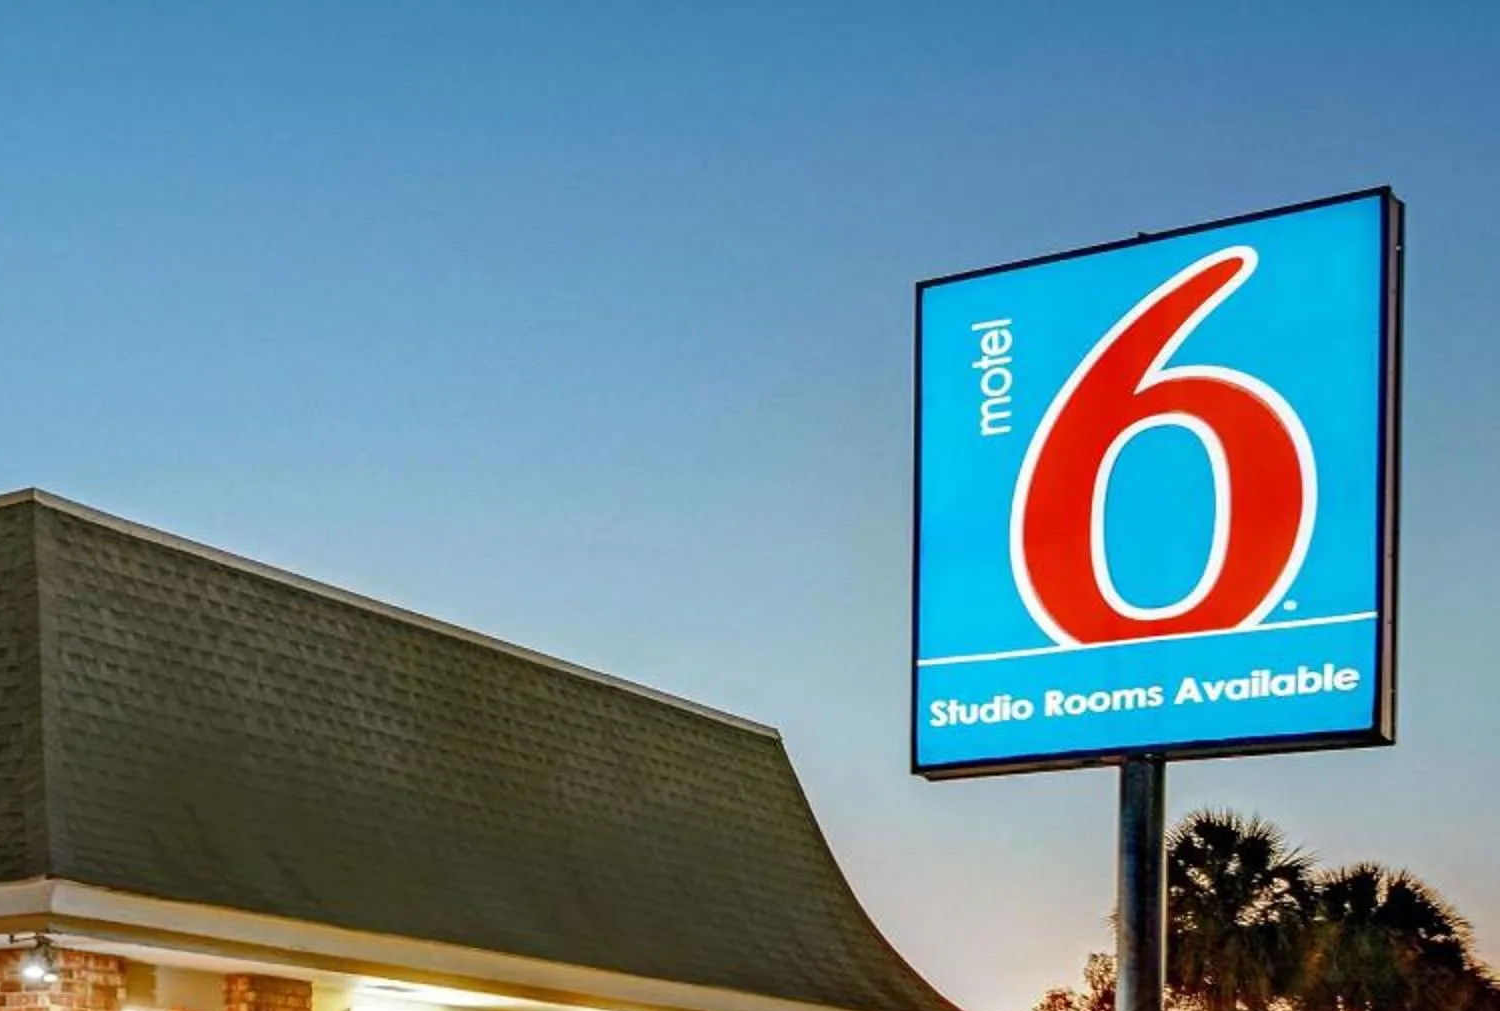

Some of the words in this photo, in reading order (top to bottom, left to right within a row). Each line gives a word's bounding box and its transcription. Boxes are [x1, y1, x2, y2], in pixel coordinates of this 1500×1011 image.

[971, 318, 1012, 436] motel
[1010, 245, 1318, 648] 6
[929, 695, 1033, 727] Studio
[1044, 683, 1164, 718] Rooms
[1174, 663, 1361, 705] Available
